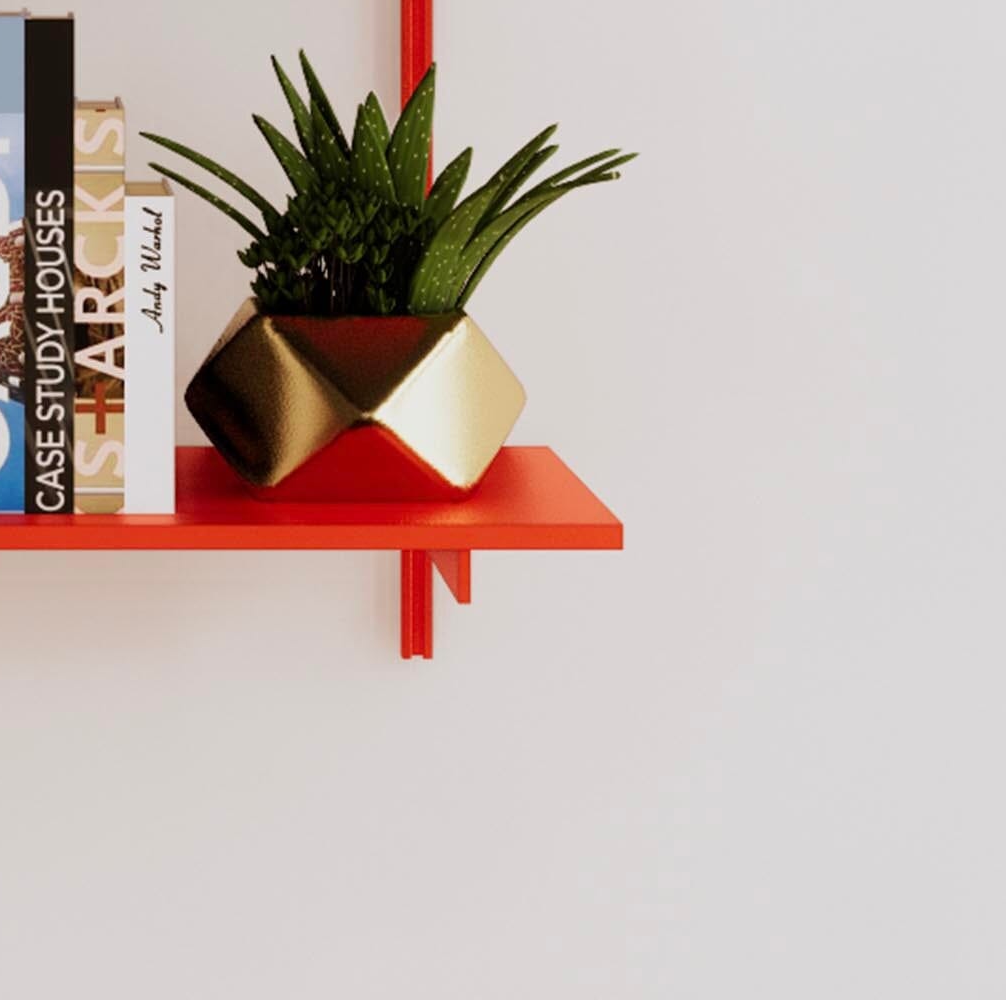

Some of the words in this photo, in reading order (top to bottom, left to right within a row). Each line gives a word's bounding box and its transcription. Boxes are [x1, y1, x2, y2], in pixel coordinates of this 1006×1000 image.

[36, 189, 65, 315] HOUSES
[140, 206, 163, 273] Warhol
[140, 282, 167, 334] Andy
[36, 321, 65, 422] STUDY
[36, 430, 65, 512] CASE
